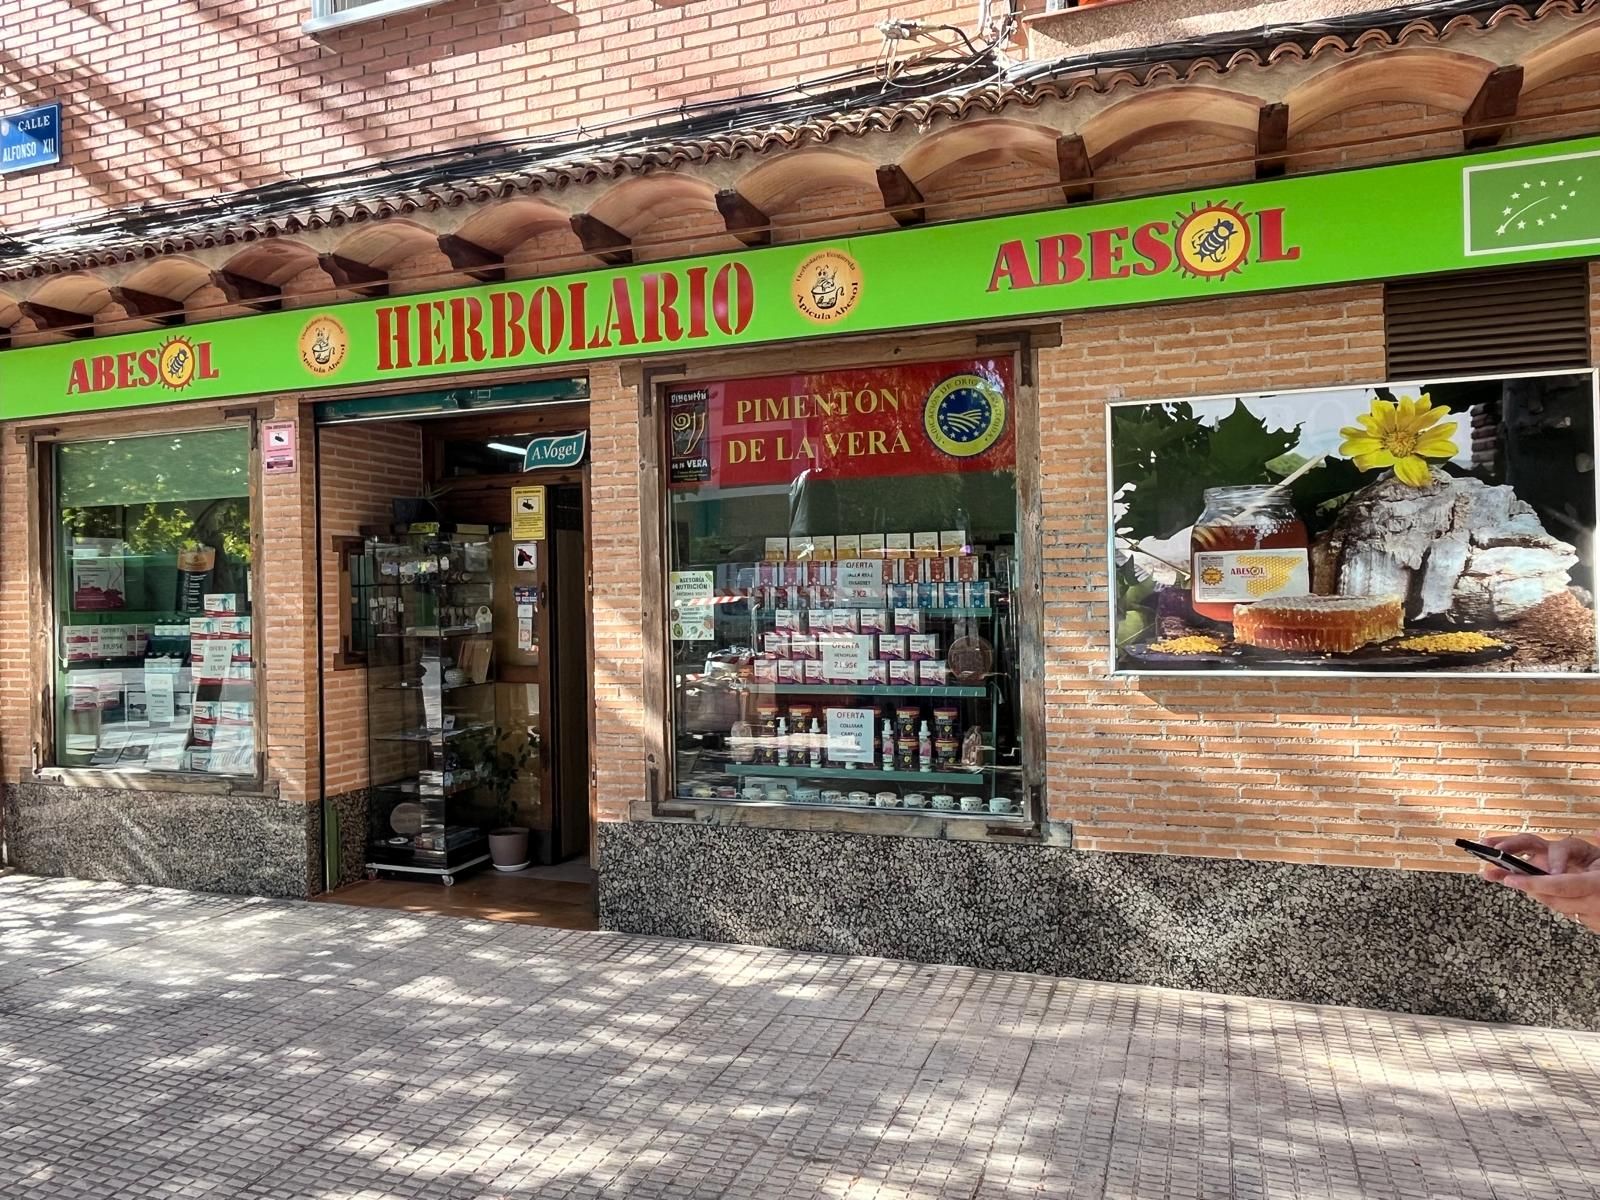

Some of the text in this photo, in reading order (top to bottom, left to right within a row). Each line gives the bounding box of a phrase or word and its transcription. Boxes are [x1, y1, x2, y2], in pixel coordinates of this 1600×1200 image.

[18, 115, 50, 132] CALLE
[3, 138, 54, 162] ALFONSO XII
[985, 201, 1301, 293] ABESOL
[835, 282, 858, 318] Abesol
[375, 262, 755, 371] HERBOLARIO
[66, 336, 219, 395] ABESOL
[737, 384, 901, 423] PIMENTÓN
[531, 441, 577, 461] A.Vogel
[728, 430, 912, 464] DE LA VERA
[686, 459, 708, 469] VERA
[845, 561, 874, 569] OFERTA
[836, 711, 865, 720] OFERTA
